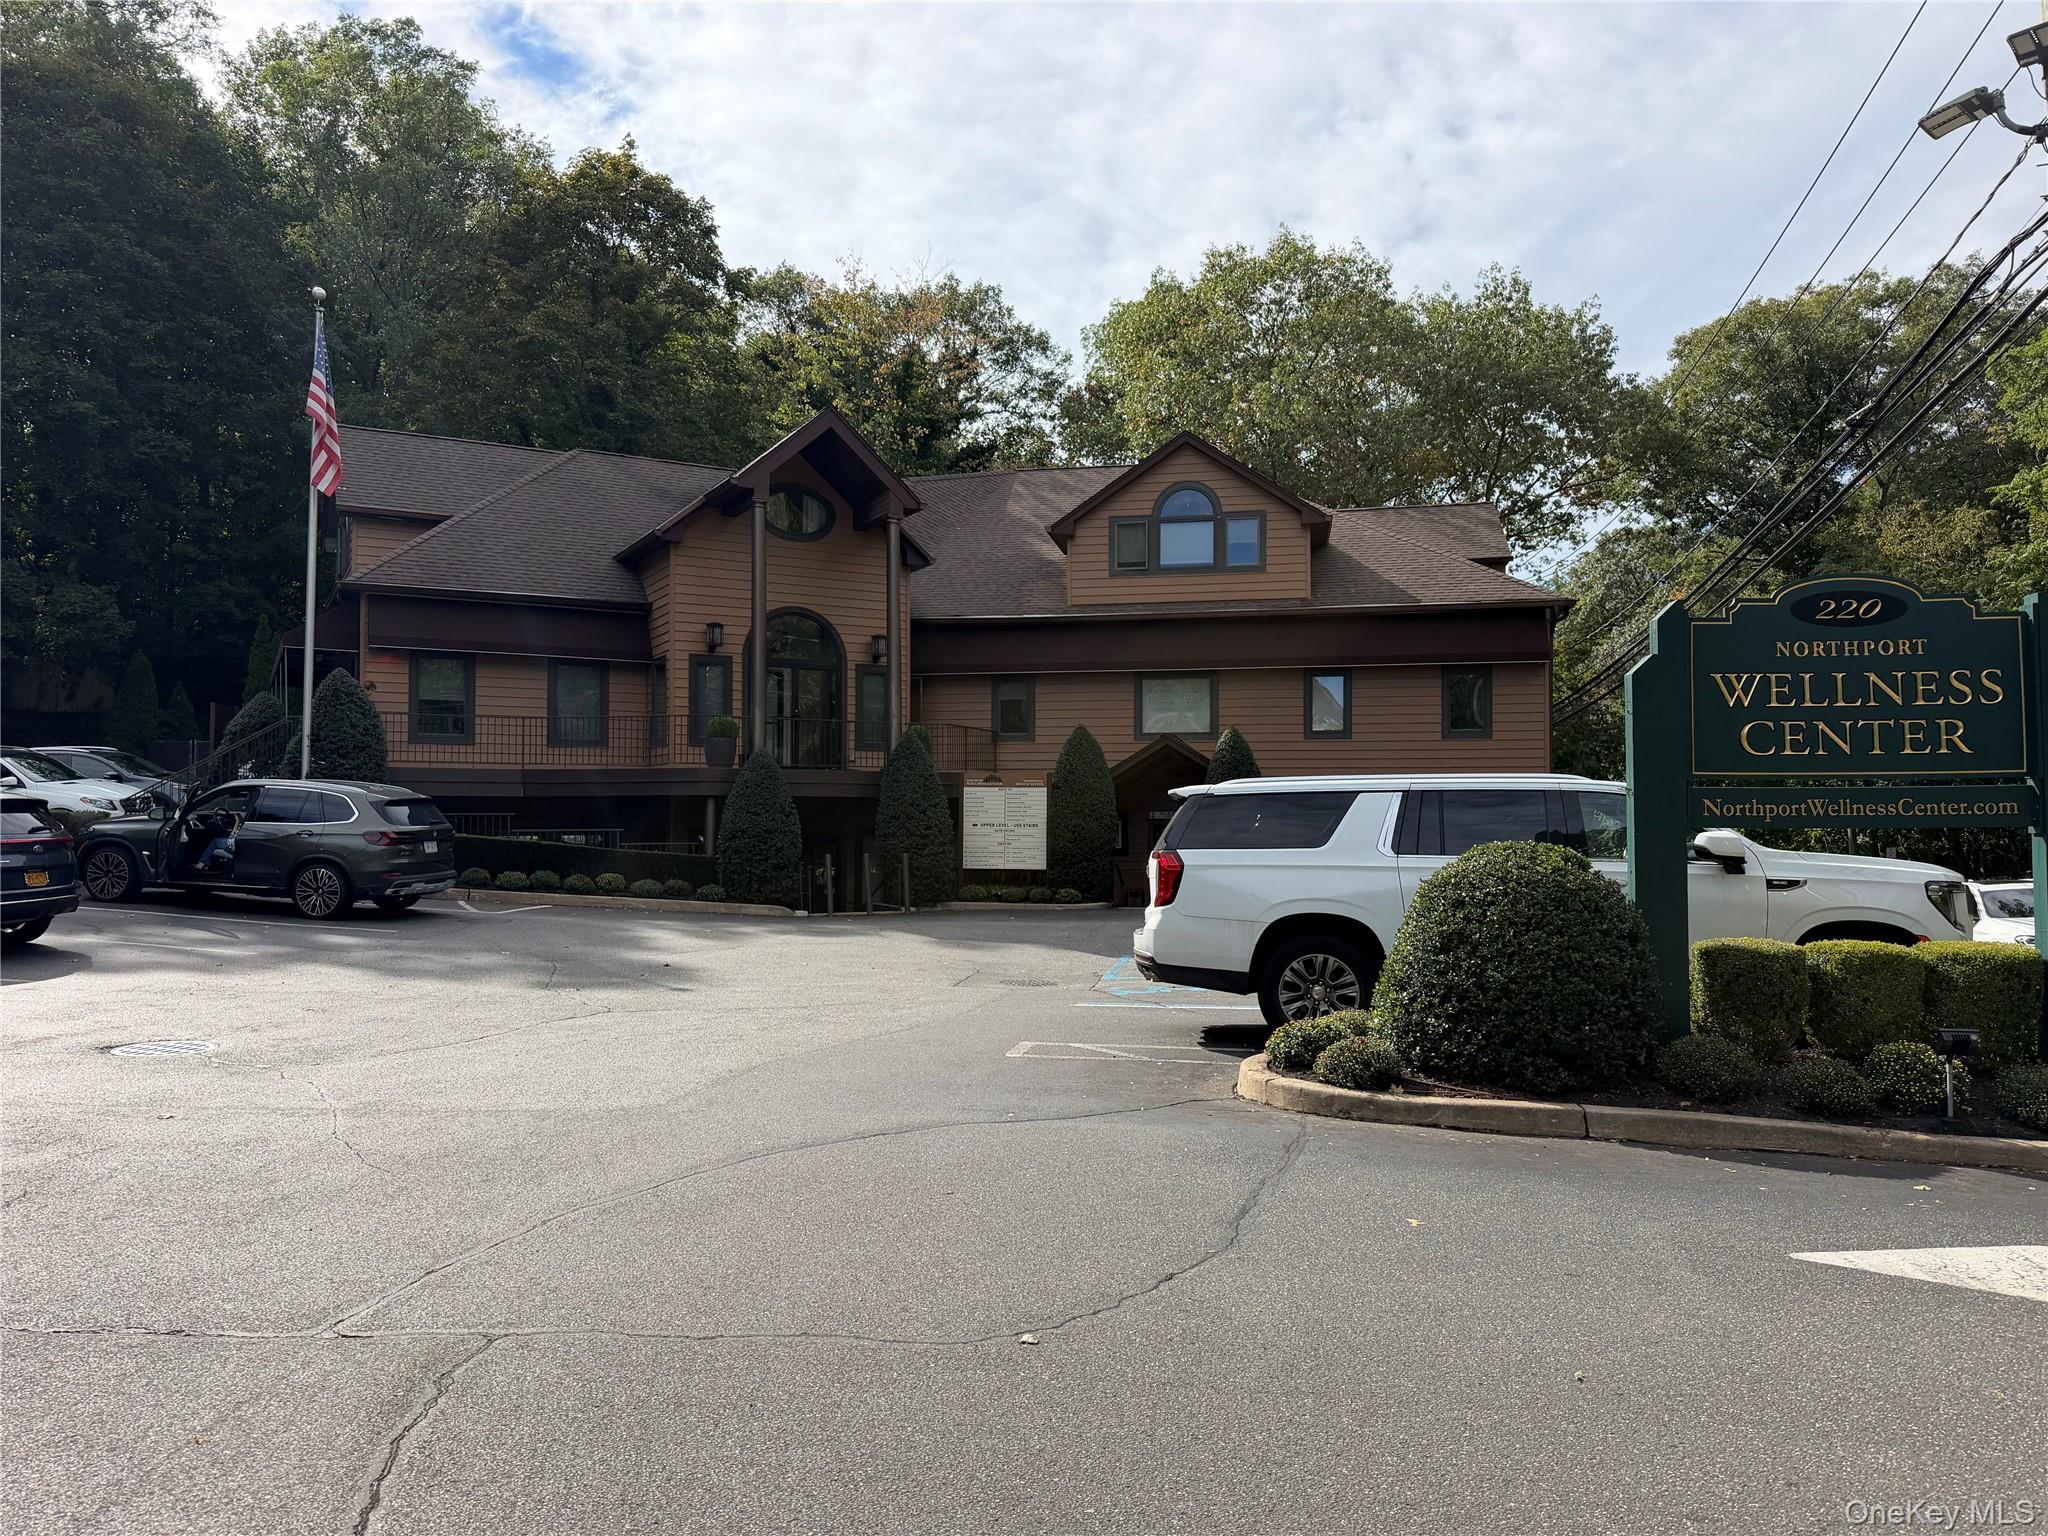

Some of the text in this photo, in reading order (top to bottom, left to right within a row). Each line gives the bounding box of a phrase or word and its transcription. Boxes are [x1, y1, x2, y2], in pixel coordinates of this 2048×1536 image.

[1815, 598, 1882, 619] 220
[1775, 638, 1927, 657] NORTHPORT
[1710, 668, 2004, 708] WELLNESS
[1740, 718, 1975, 756] CENTER
[1703, 798, 2019, 822] NorthportWellnessCenter.com
